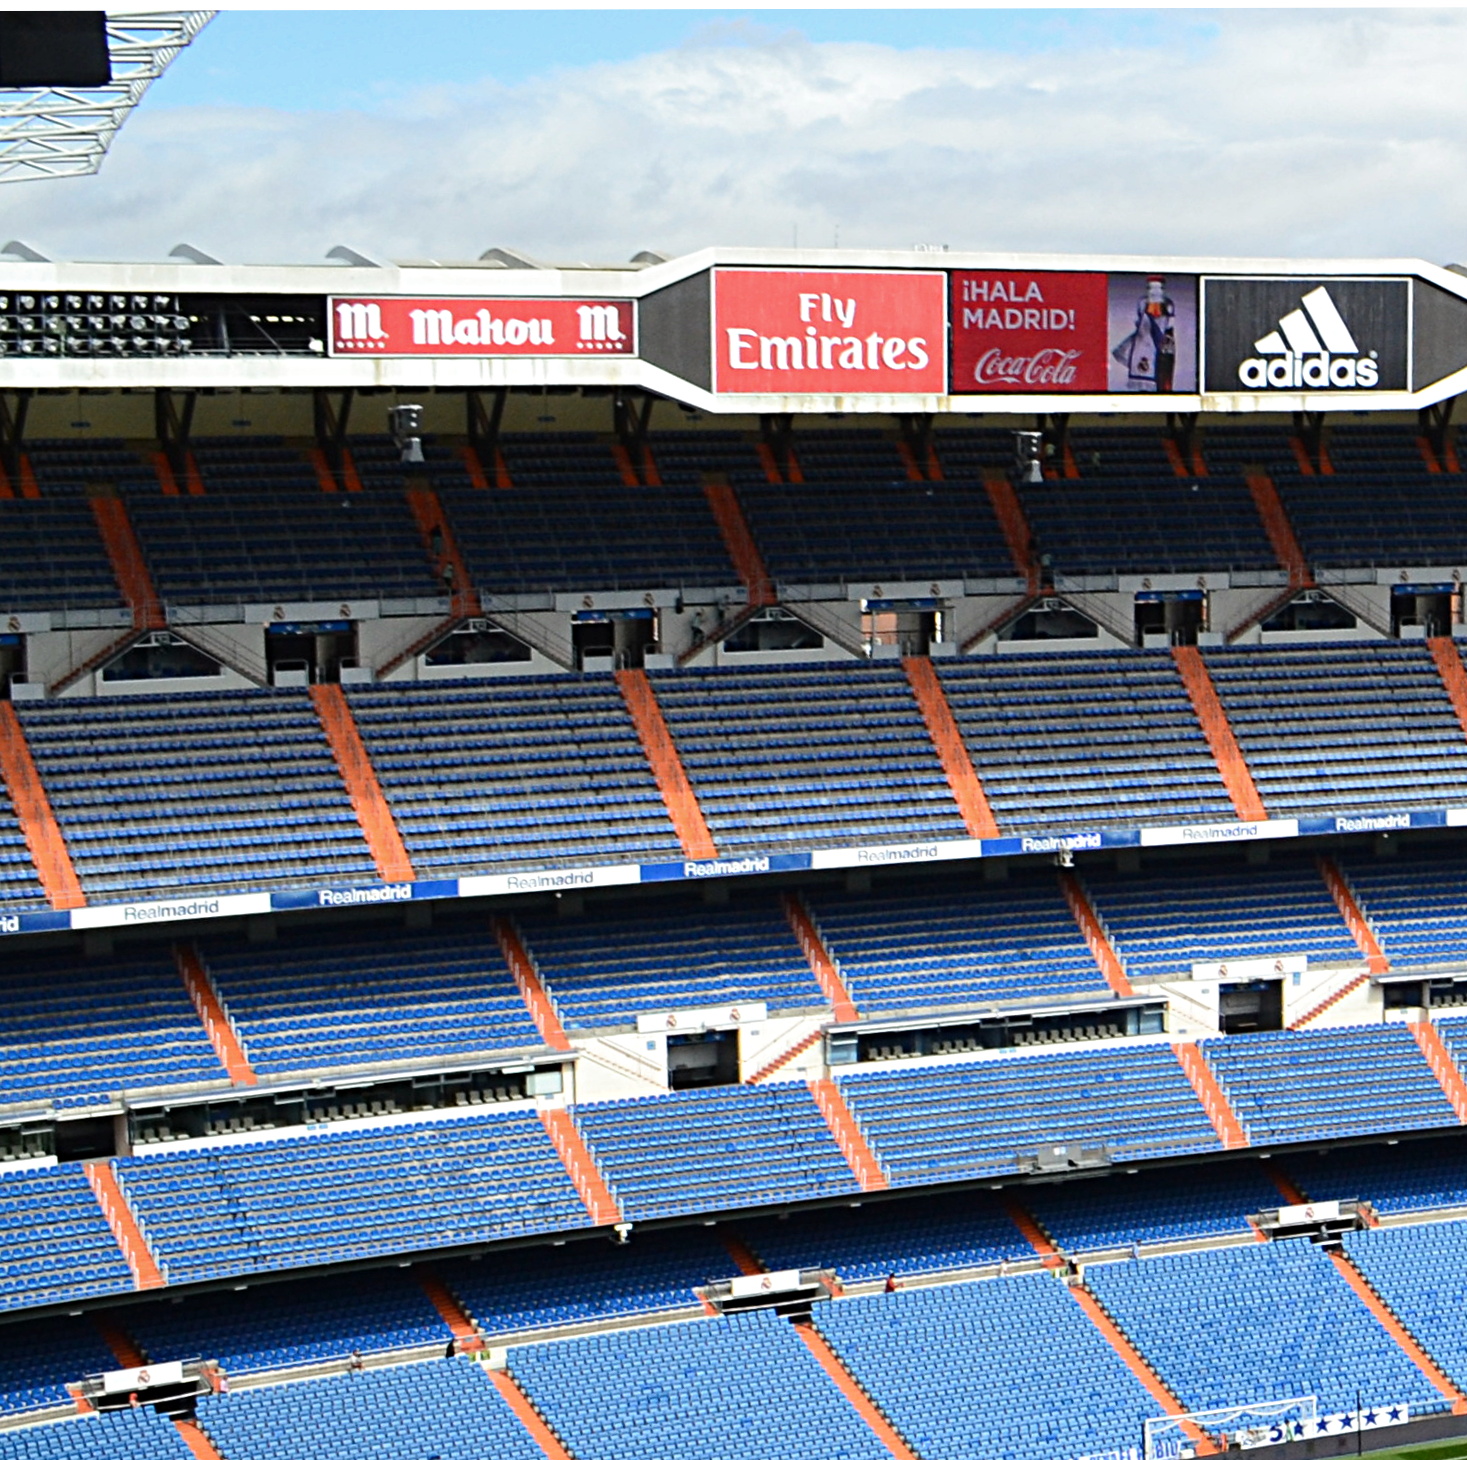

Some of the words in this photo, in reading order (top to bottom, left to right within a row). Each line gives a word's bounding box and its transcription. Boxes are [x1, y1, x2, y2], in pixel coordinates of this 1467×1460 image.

[962, 279, 1043, 303] ¡HALA
[799, 293, 856, 328] Fly
[962, 308, 1076, 330] MADRID!
[410, 309, 554, 345] Mahou
[727, 327, 929, 371] Emirates
[1239, 352, 1379, 389] adidas
[1182, 825, 1257, 841] Realmadrid
[1337, 815, 1411, 830] Realmadrid
[1022, 834, 1101, 851] Realmadrid
[857, 845, 937, 863] Realmadrid
[684, 857, 770, 876] Realmadrid
[507, 871, 593, 889] Realmadrid
[320, 884, 411, 905] Realmadrid
[124, 900, 219, 921] Realmadrid
